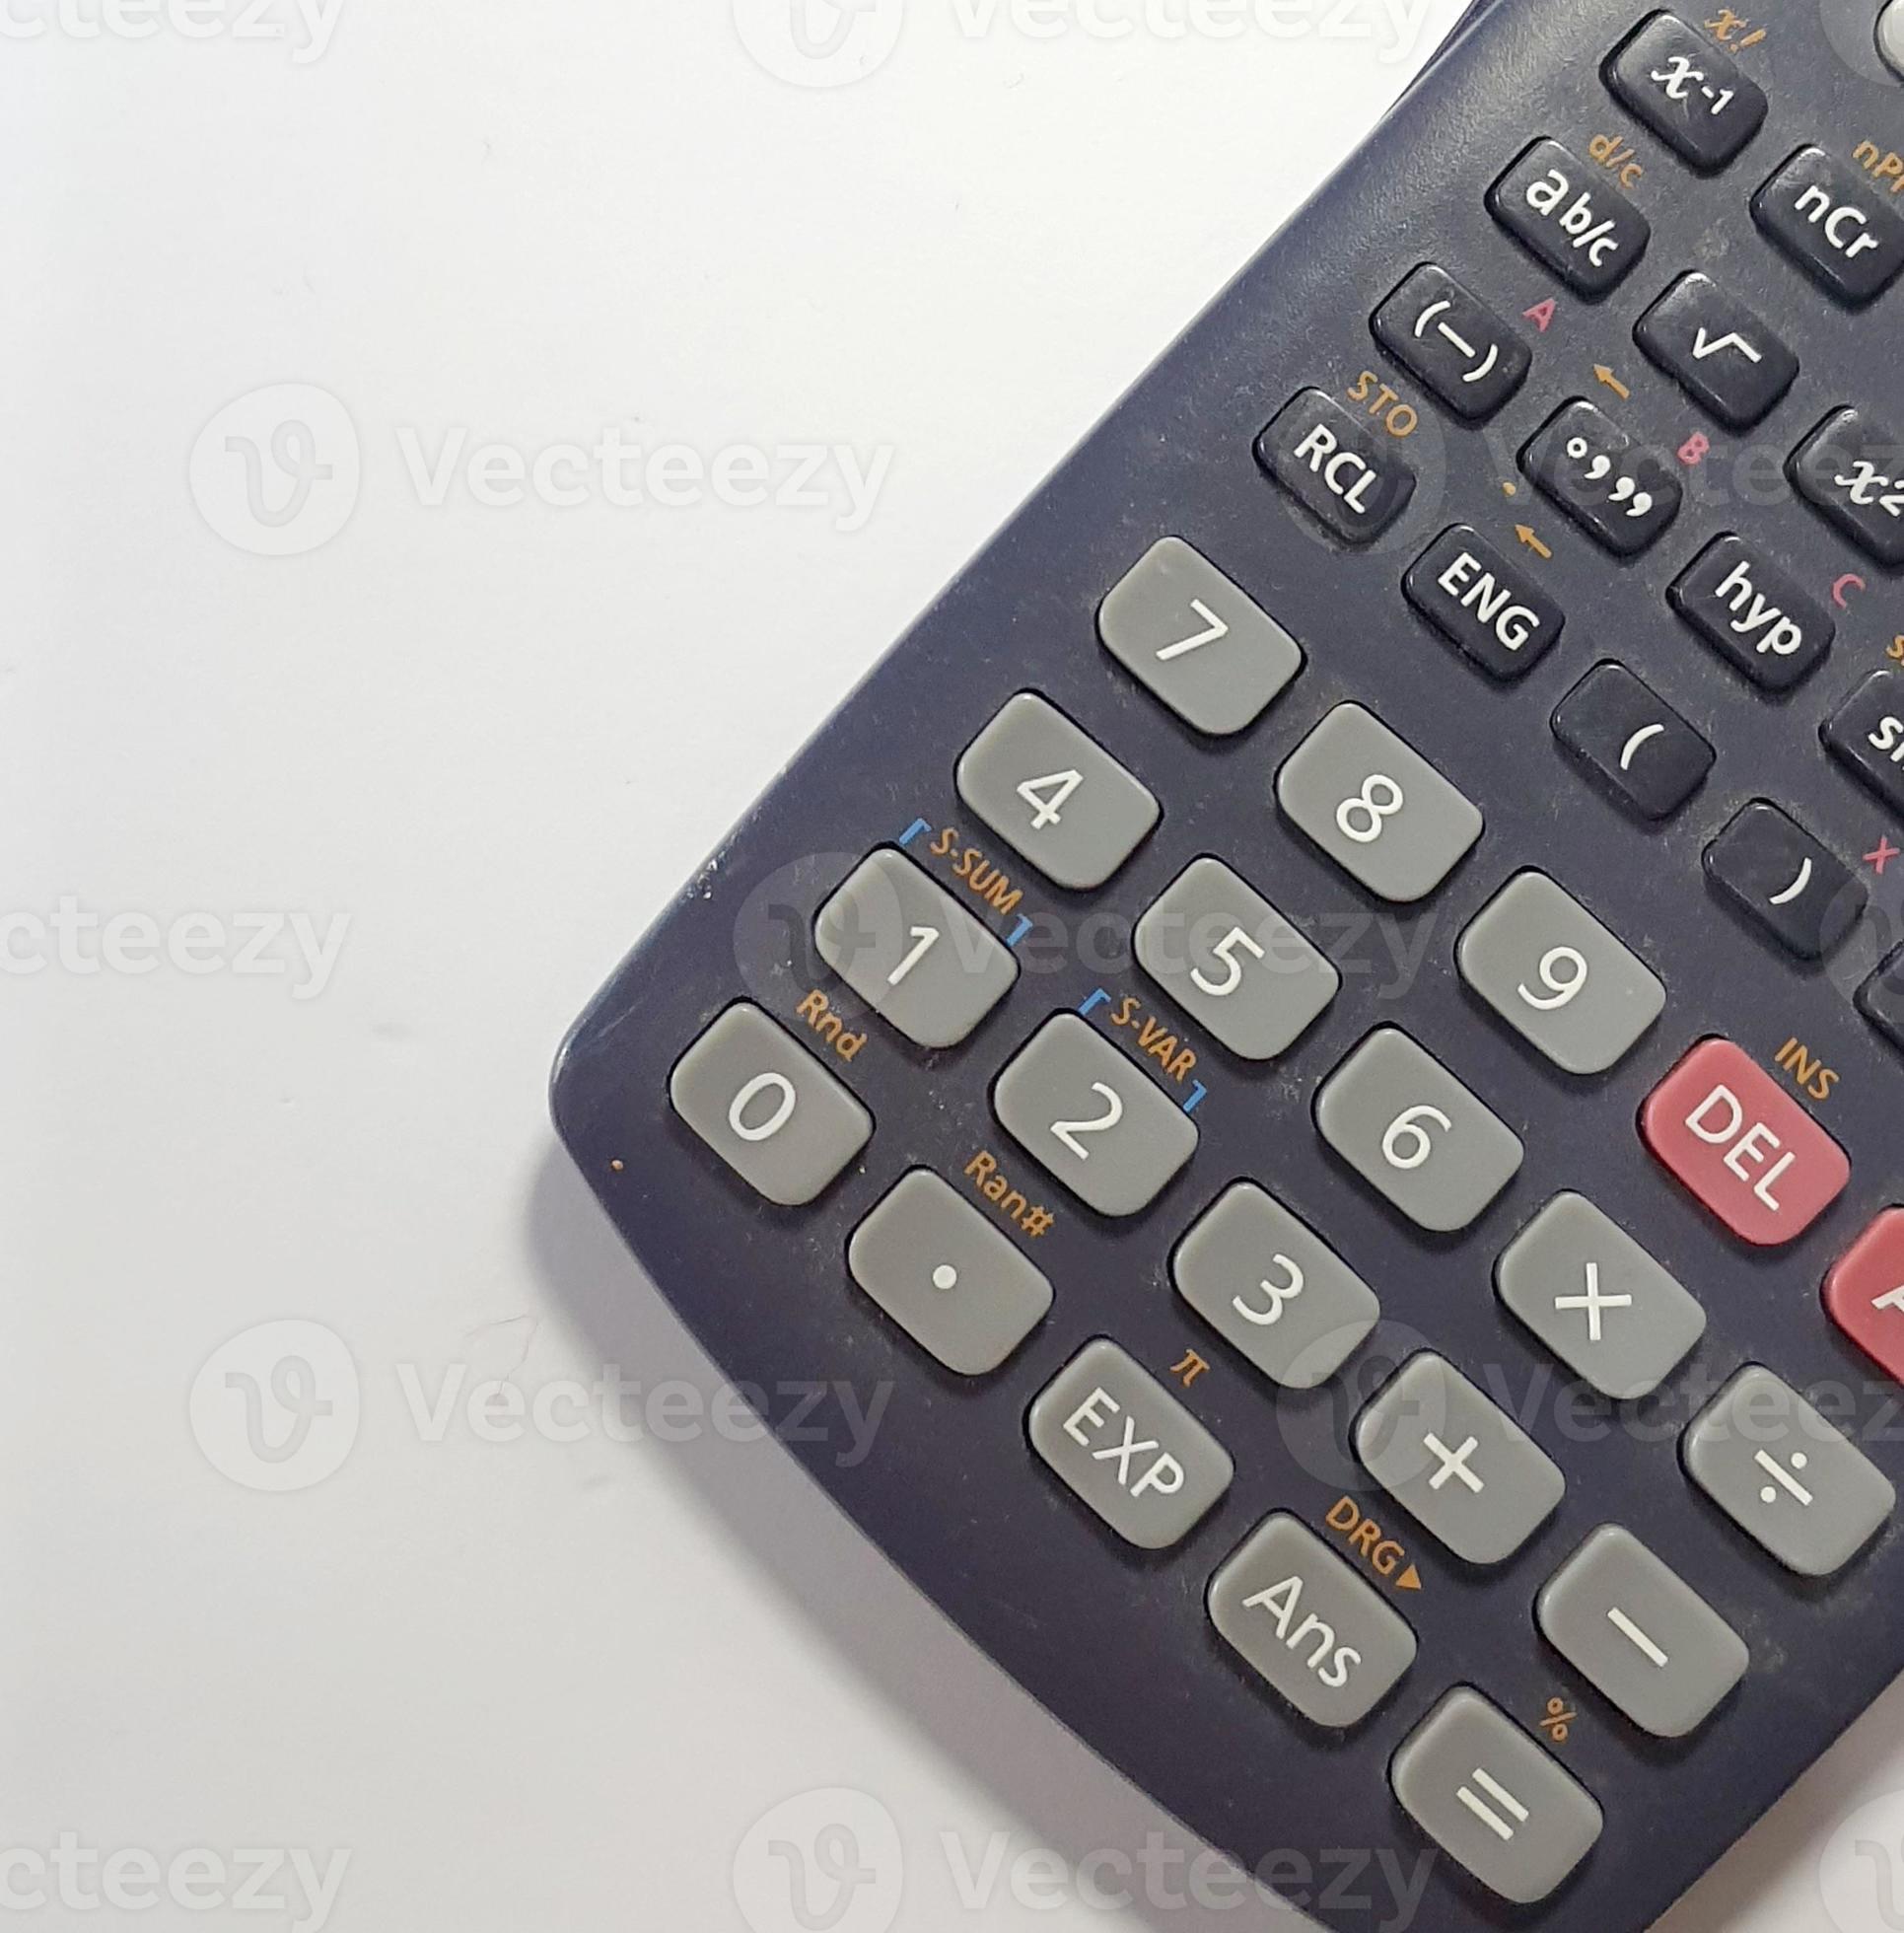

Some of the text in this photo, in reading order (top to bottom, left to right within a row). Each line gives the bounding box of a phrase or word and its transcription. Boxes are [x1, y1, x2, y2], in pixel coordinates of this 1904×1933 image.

[1795, 184, 1878, 257] nCr
[1522, 299, 1557, 333] A
[1347, 371, 1418, 437] STO
[1294, 423, 1376, 514] RCL
[1675, 432, 1709, 467] B
[1438, 552, 1540, 651] ENG
[1715, 560, 1801, 655] hyp
[1830, 573, 1866, 609] C
[1156, 599, 1229, 660] 7
[1017, 769, 1083, 829] 4
[1336, 774, 1403, 842] 8
[931, 830, 1023, 915] S-SUM
[887, 926, 939, 984] 1
[1190, 927, 1265, 995] 5
[1517, 946, 1587, 1010] 9
[797, 989, 868, 1060] Rnd
[1111, 999, 1196, 1082] S-VAR
[1776, 1039, 1837, 1100] INS
[729, 1072, 796, 1141] 0
[1050, 1082, 1122, 1159] 2
[1382, 1106, 1451, 1169] 6
[1685, 1084, 1796, 1212] DEL
[964, 1152, 1054, 1237] Ran#
[1233, 1253, 1304, 1324] 3
[1063, 1388, 1184, 1497] EXP
[1243, 1576, 1361, 1686] Ans
